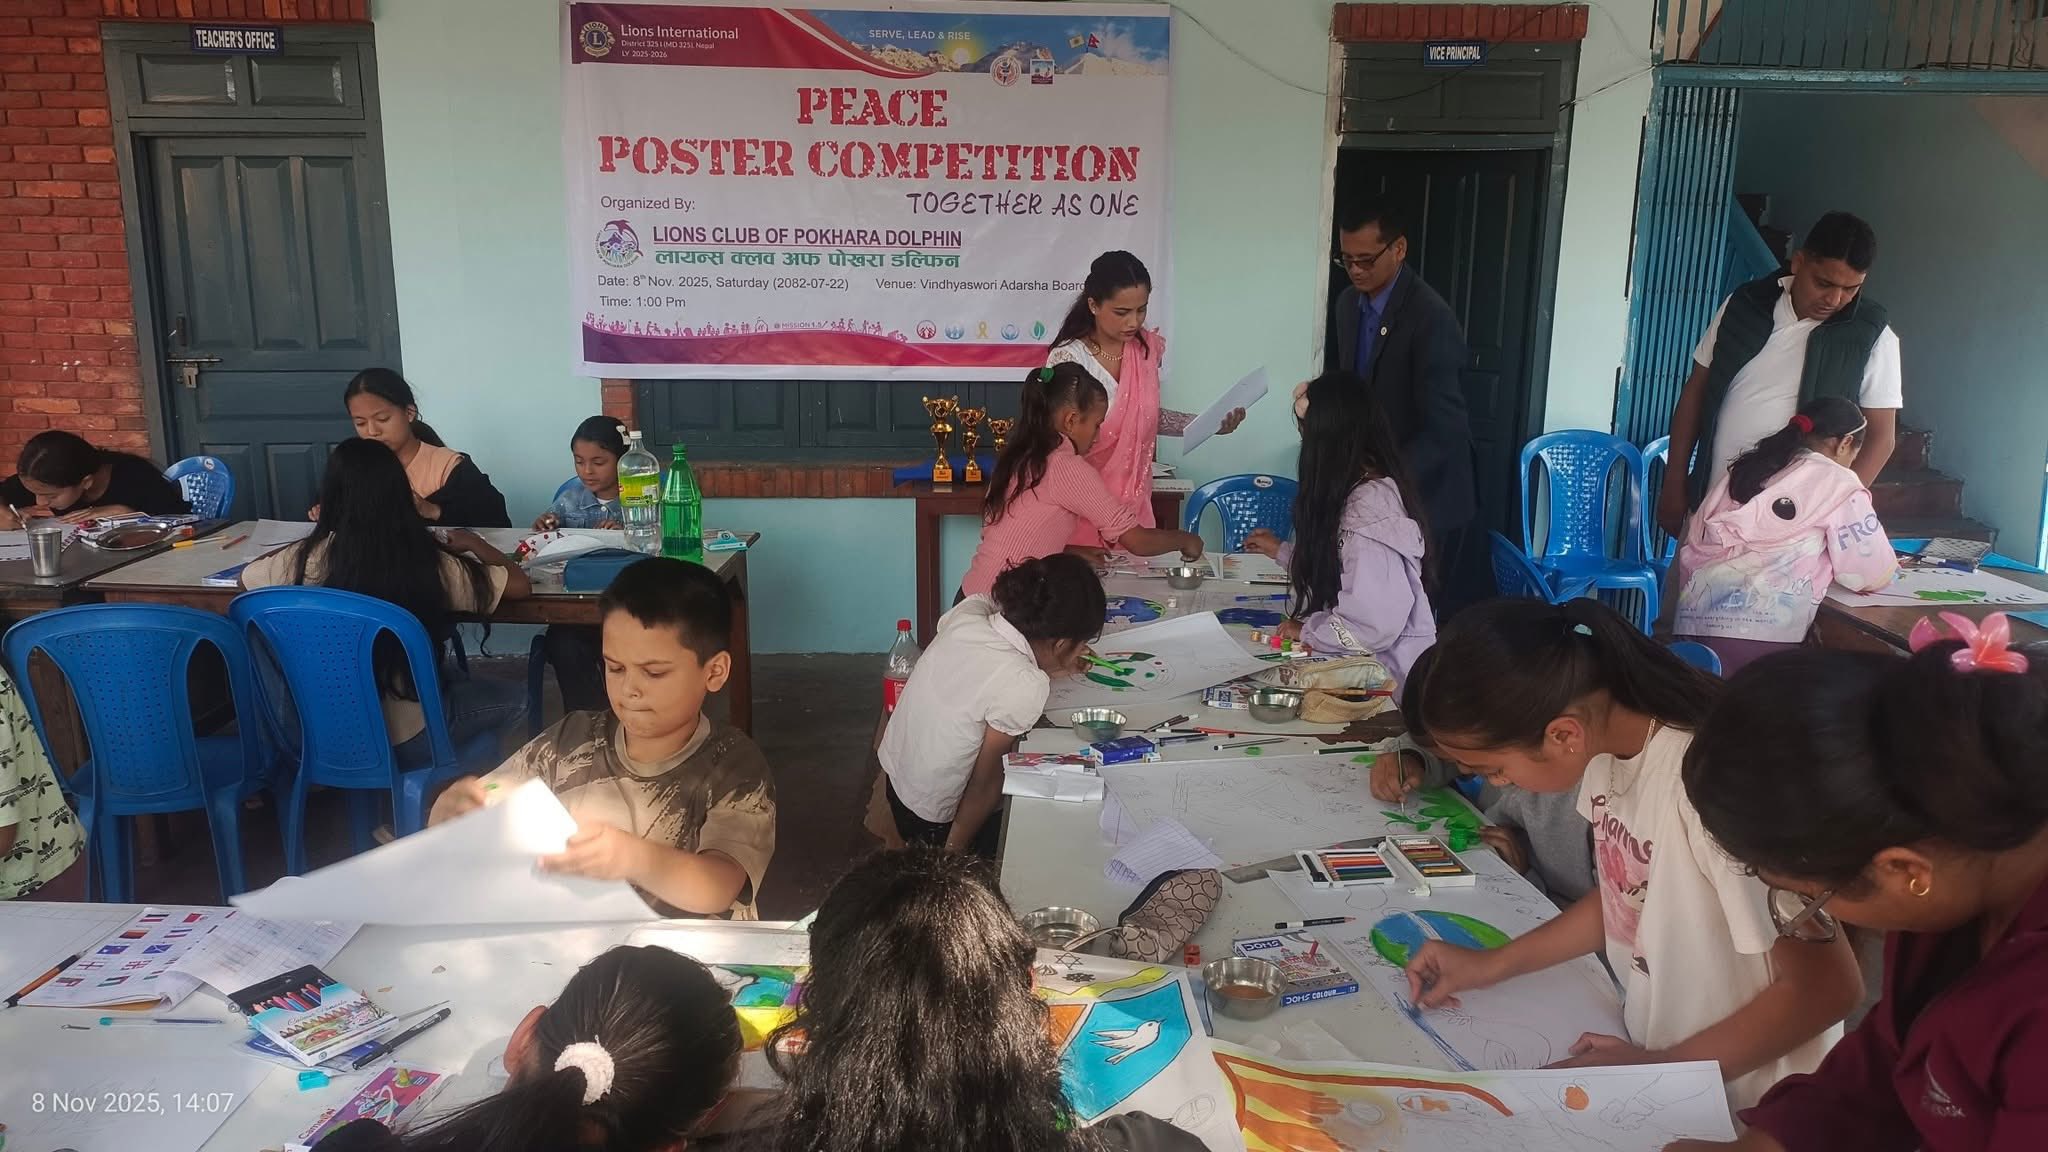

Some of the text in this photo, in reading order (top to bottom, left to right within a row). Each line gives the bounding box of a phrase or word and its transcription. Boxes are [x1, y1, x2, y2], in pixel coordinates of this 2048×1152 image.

[195, 29, 275, 49] TEACHER'S OFFICE
[620, 24, 739, 40] Lions International
[868, 29, 971, 41] SERVE, LEAD & RISE
[647, 40, 659, 48] 325
[696, 42, 715, 50] Nepal
[1429, 46, 1480, 60] VICE PRINCIPAL
[796, 87, 948, 127] PEACE
[598, 135, 1140, 182] POSTER COMPETITION
[600, 195, 696, 212] Organized By:
[906, 190, 1139, 217] TOGETHER AS ONE
[653, 226, 962, 246] LIONS CLUB OF POKHARA DOLPHIN
[655, 250, 725, 265] लायन्स
[782, 252, 821, 266] अफ
[828, 249, 885, 267] पोखरा
[891, 250, 961, 268] डल्फिन
[598, 275, 629, 287] Date:
[648, 276, 674, 287] Nov.
[679, 276, 712, 289] 2025,
[716, 276, 769, 290] Saturday
[773, 277, 849, 291] (2082-07-22)
[876, 278, 917, 289] Venue:
[920, 278, 998, 292] Vindhyaswori
[1000, 280, 1048, 291] Adarsha
[600, 295, 686, 307] Time: 1:00 Pm
[1312, 989, 1337, 999] COLOUR
